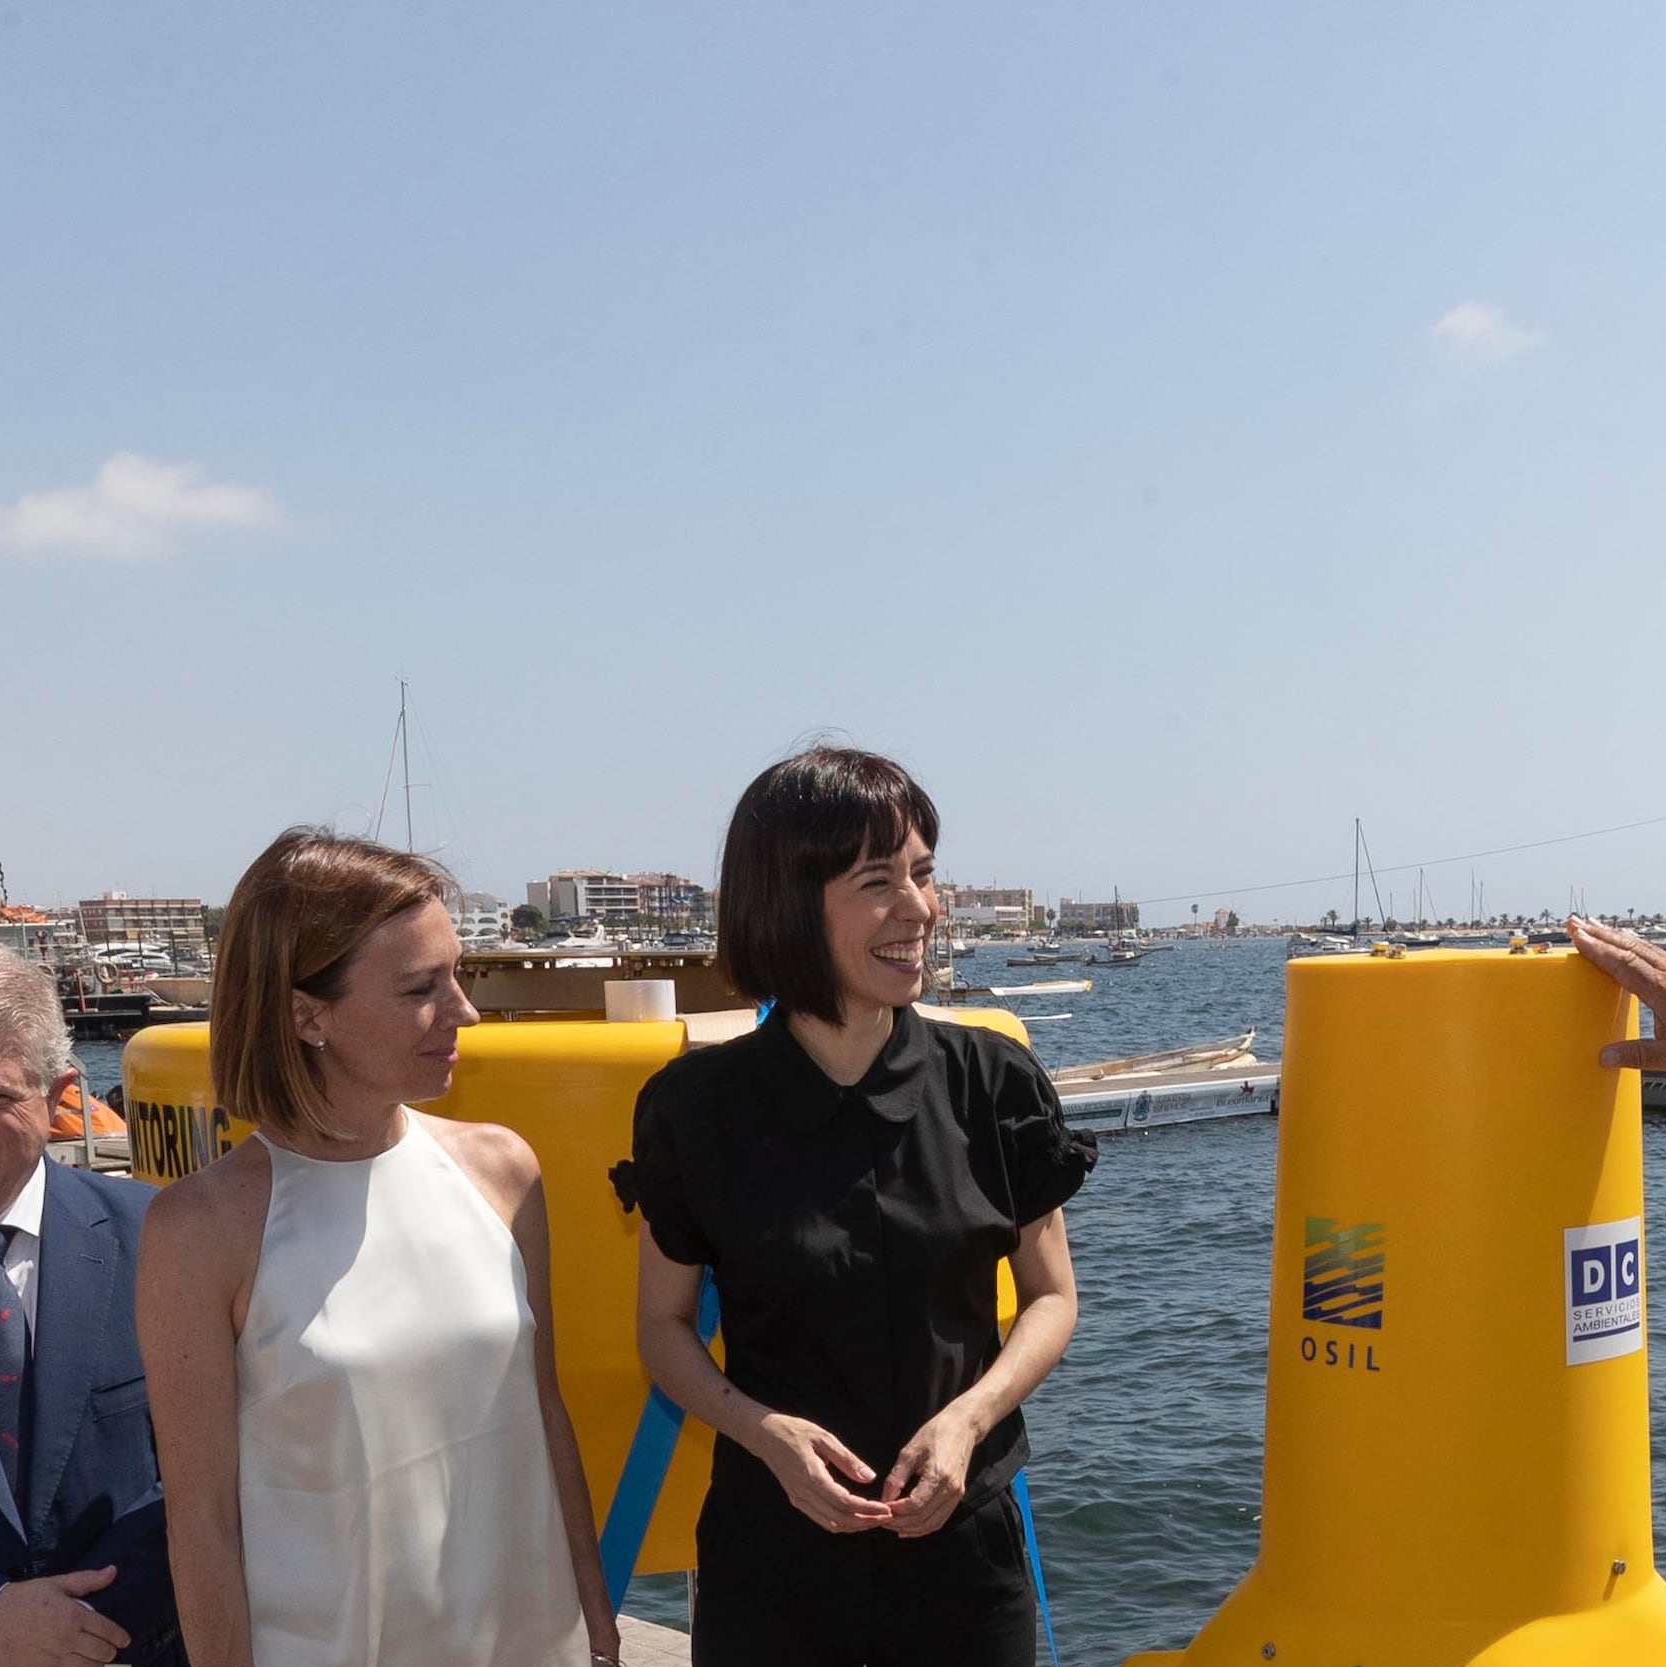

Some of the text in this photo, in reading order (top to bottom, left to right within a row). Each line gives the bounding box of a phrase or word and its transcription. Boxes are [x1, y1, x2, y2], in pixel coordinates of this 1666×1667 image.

[1572, 1297, 1640, 1320] SERVICIOS
[1573, 1309, 1640, 1334] AMBIENTALES
[1301, 1336, 1381, 1371] OSIL
